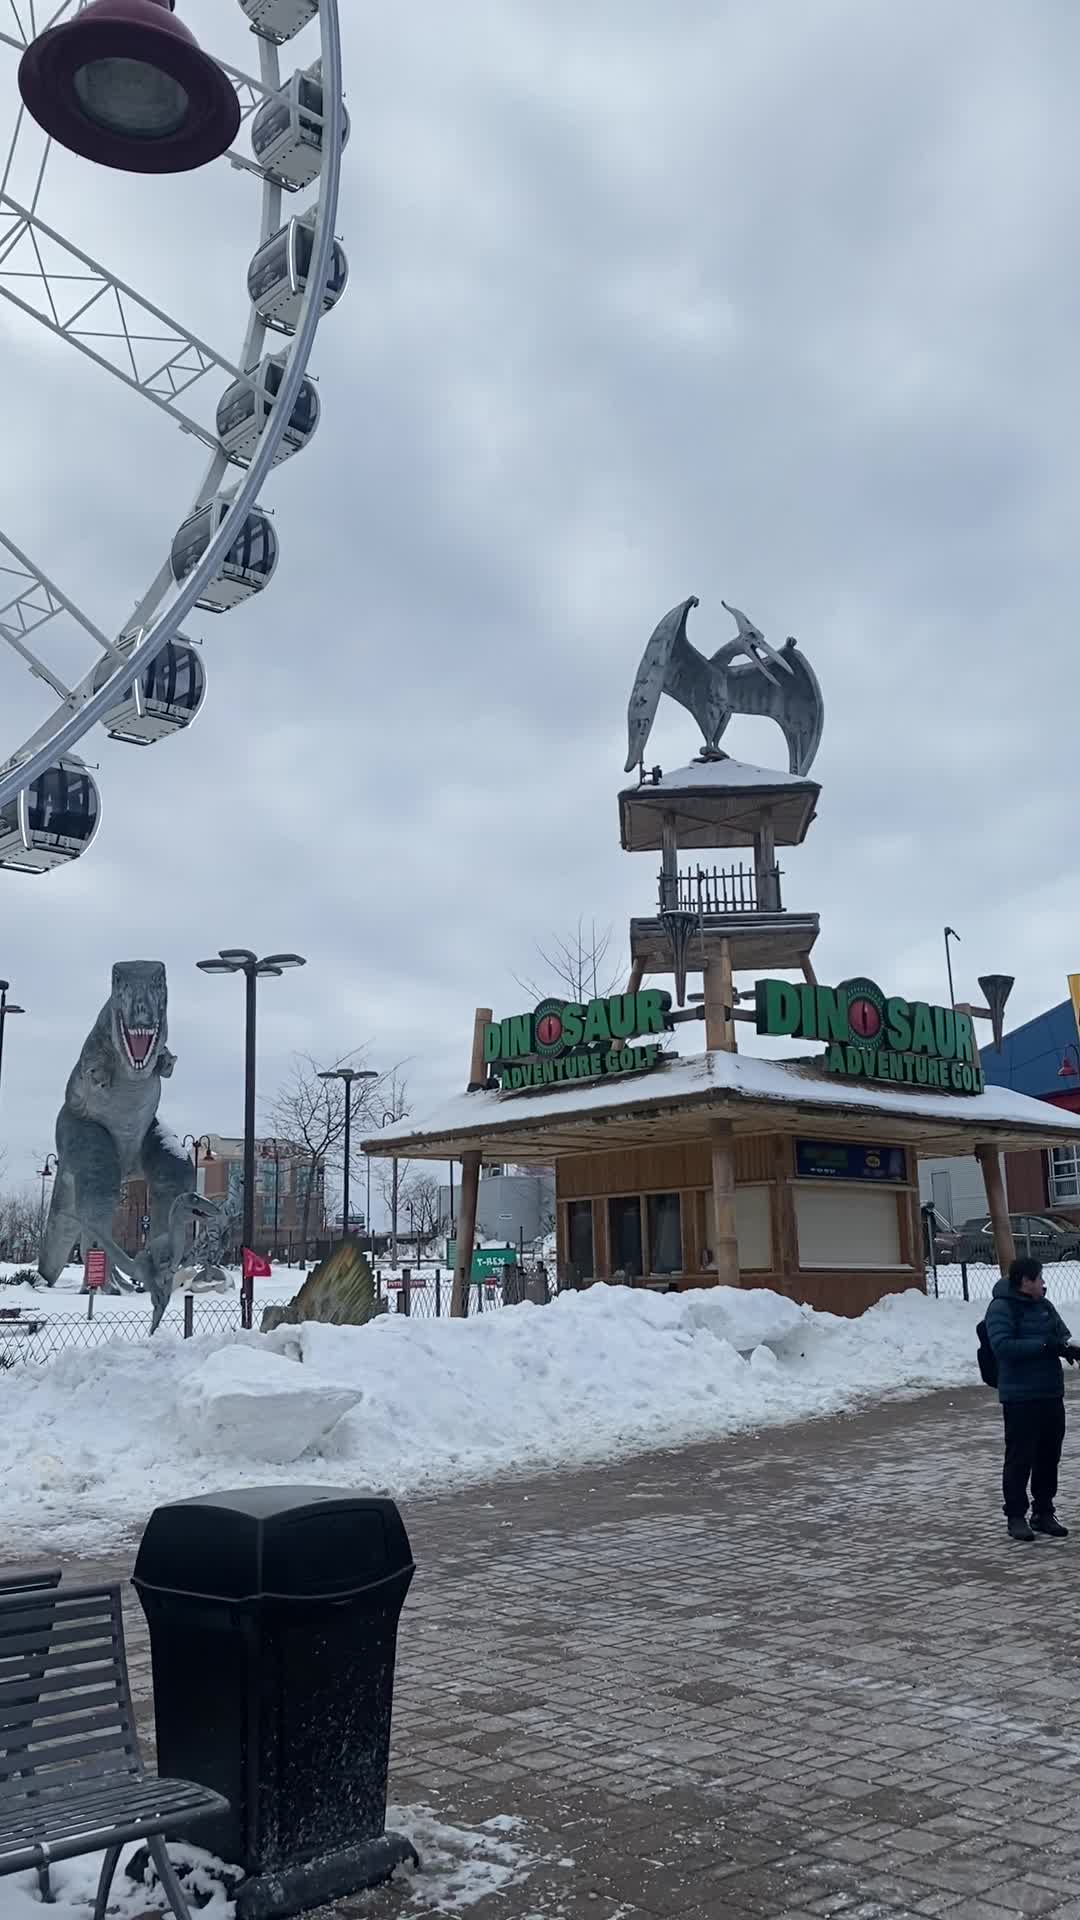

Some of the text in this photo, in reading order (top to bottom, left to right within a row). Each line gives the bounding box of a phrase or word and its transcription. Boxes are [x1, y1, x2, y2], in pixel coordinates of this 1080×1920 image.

[483, 988, 672, 1063] DINOSAUR
[755, 977, 973, 1062] DINOSAUR
[501, 1044, 662, 1090] ADVENTURE GOLF
[826, 1046, 985, 1095] ADVENTURE GOLF
